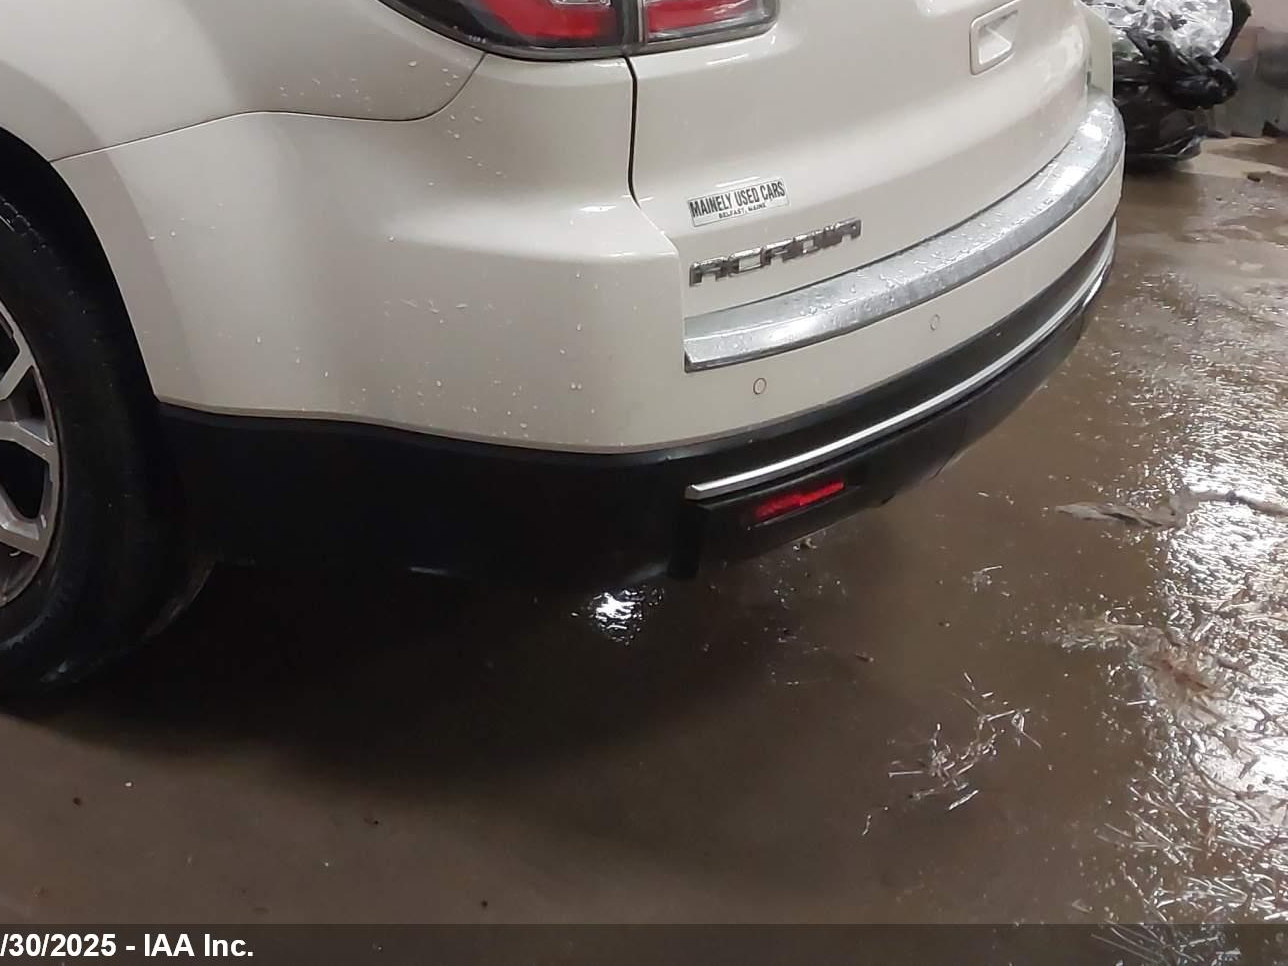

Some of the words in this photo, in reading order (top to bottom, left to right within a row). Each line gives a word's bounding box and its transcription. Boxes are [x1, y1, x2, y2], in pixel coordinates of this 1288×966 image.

[689, 193, 732, 218] MAINELY
[734, 187, 760, 207] USED
[759, 181, 786, 201] CARS
[689, 218, 862, 287] ACADIA
